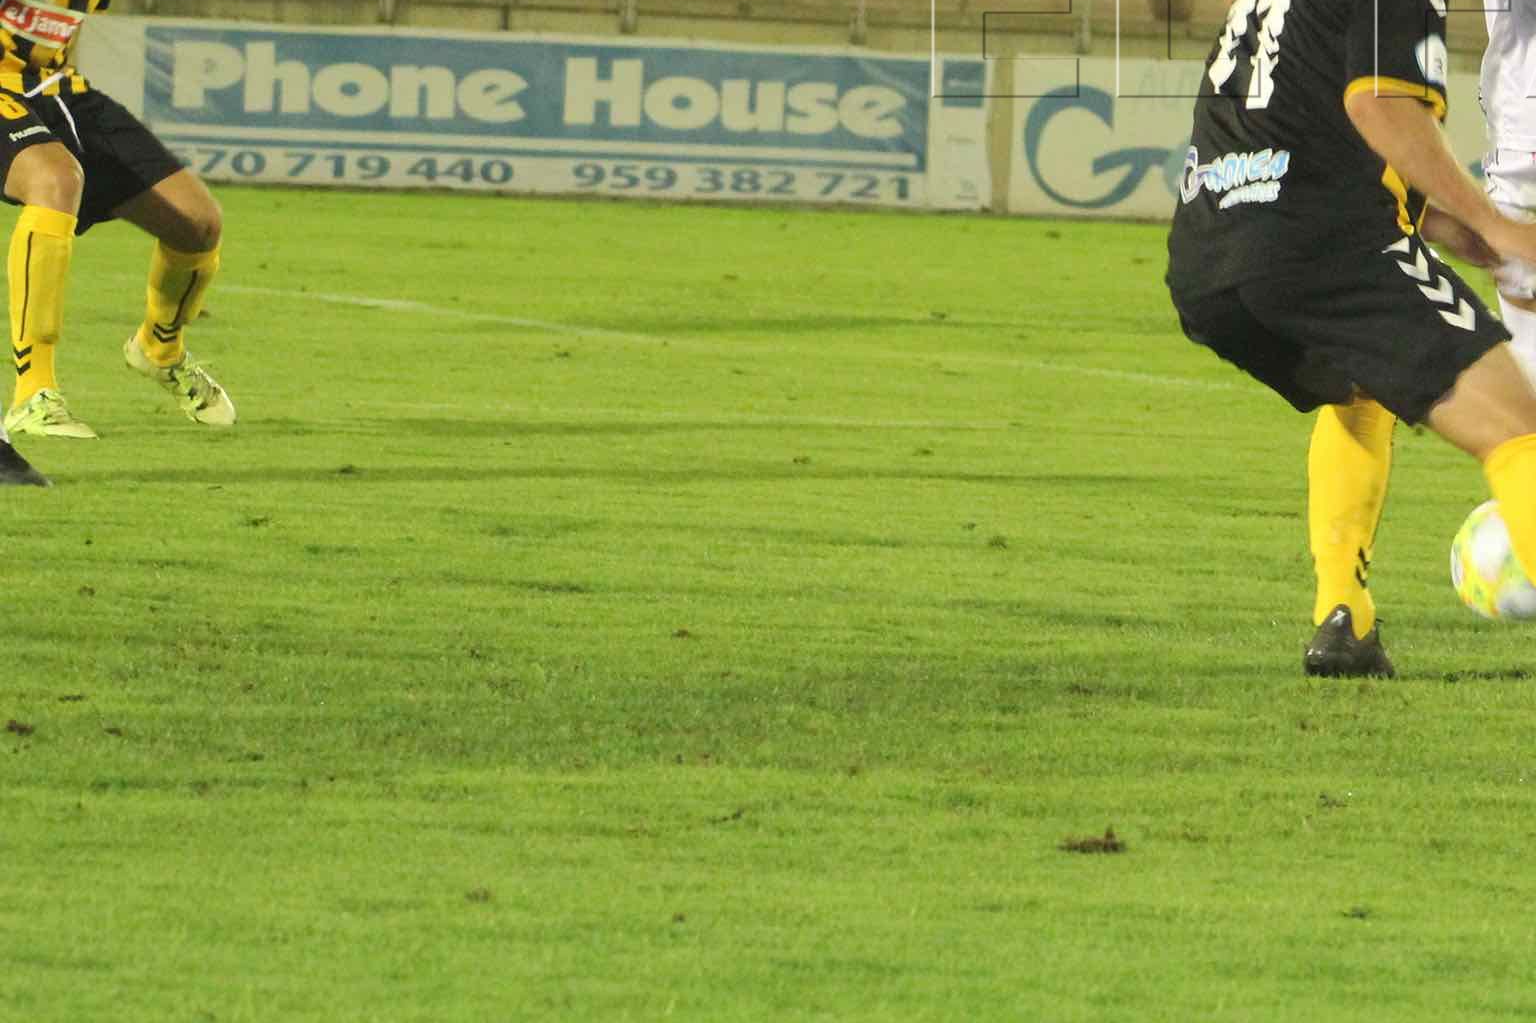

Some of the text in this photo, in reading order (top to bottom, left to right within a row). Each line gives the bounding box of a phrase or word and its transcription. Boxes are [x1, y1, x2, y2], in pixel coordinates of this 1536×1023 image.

[172, 38, 907, 138] Phone House
[182, 148, 911, 201] 70 719 440 959 382 721
